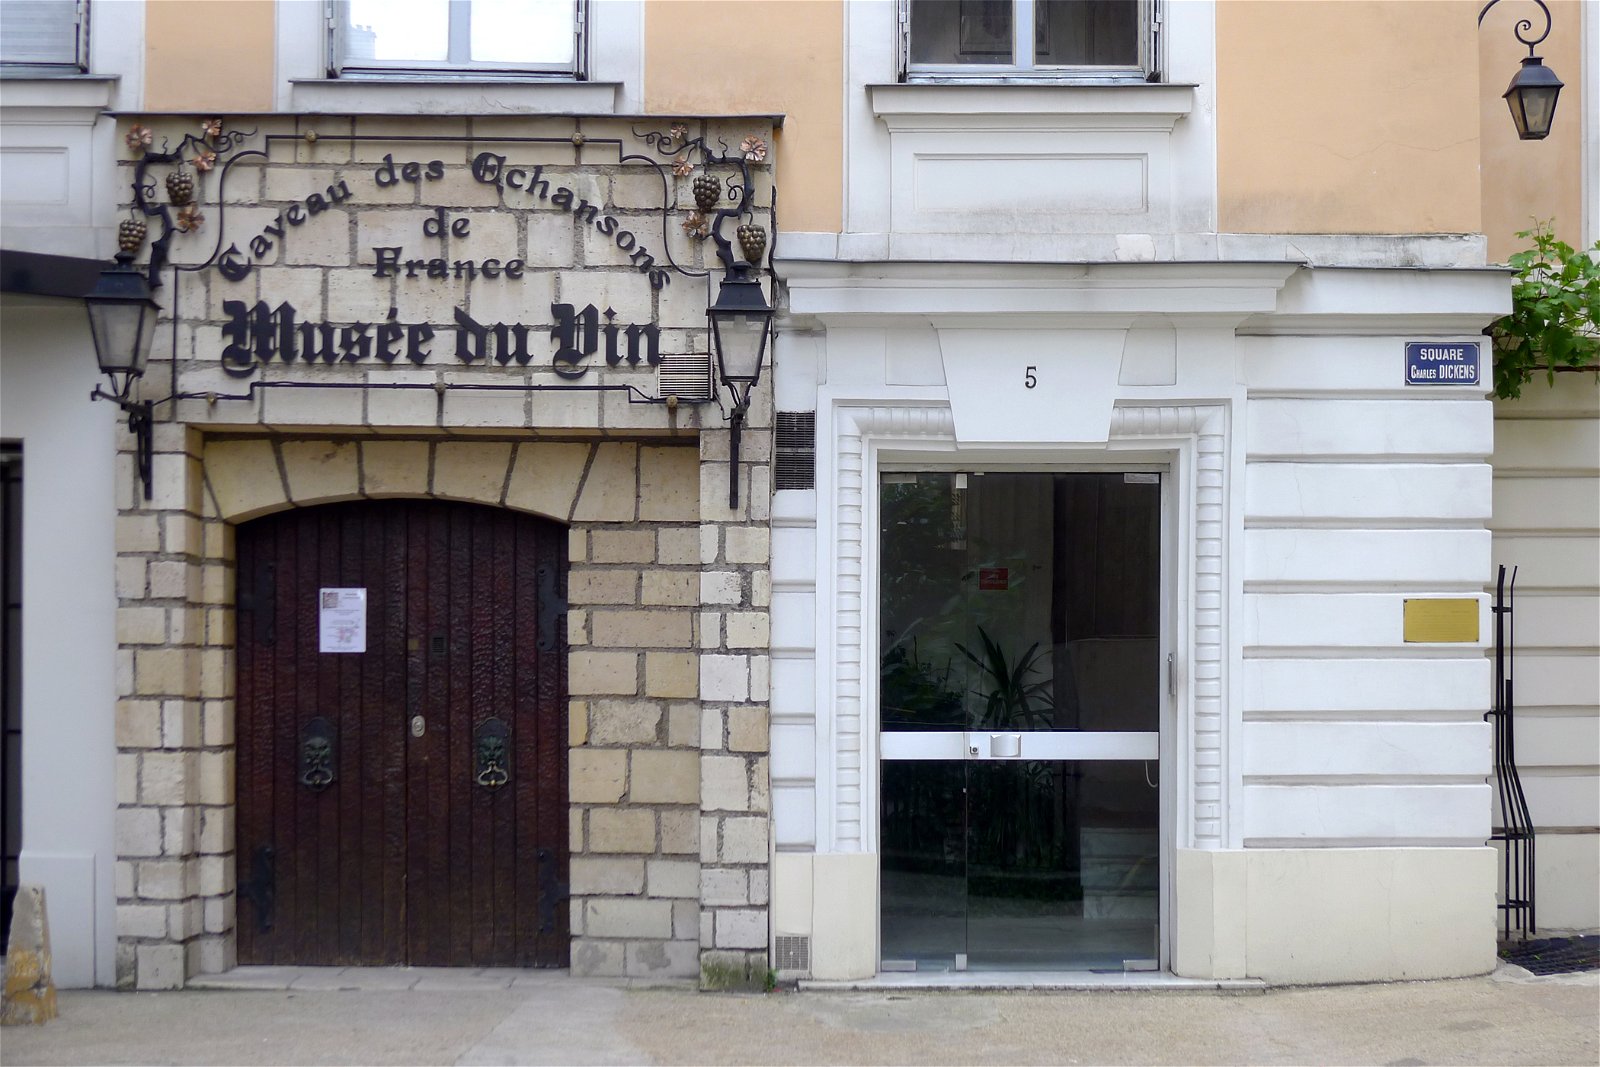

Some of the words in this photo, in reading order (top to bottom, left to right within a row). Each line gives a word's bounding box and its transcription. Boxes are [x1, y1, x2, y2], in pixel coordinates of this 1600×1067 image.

[219, 180, 353, 282] Caveau
[375, 153, 445, 188] des
[471, 151, 670, 291] Echansons
[422, 206, 471, 239] de
[372, 246, 526, 280] France
[221, 299, 436, 379] Musée
[454, 305, 534, 367] du
[550, 302, 664, 380] Vin
[1420, 348, 1464, 361] SQUARE
[1025, 366, 1037, 389] 5
[1439, 364, 1475, 379] DICKENS
